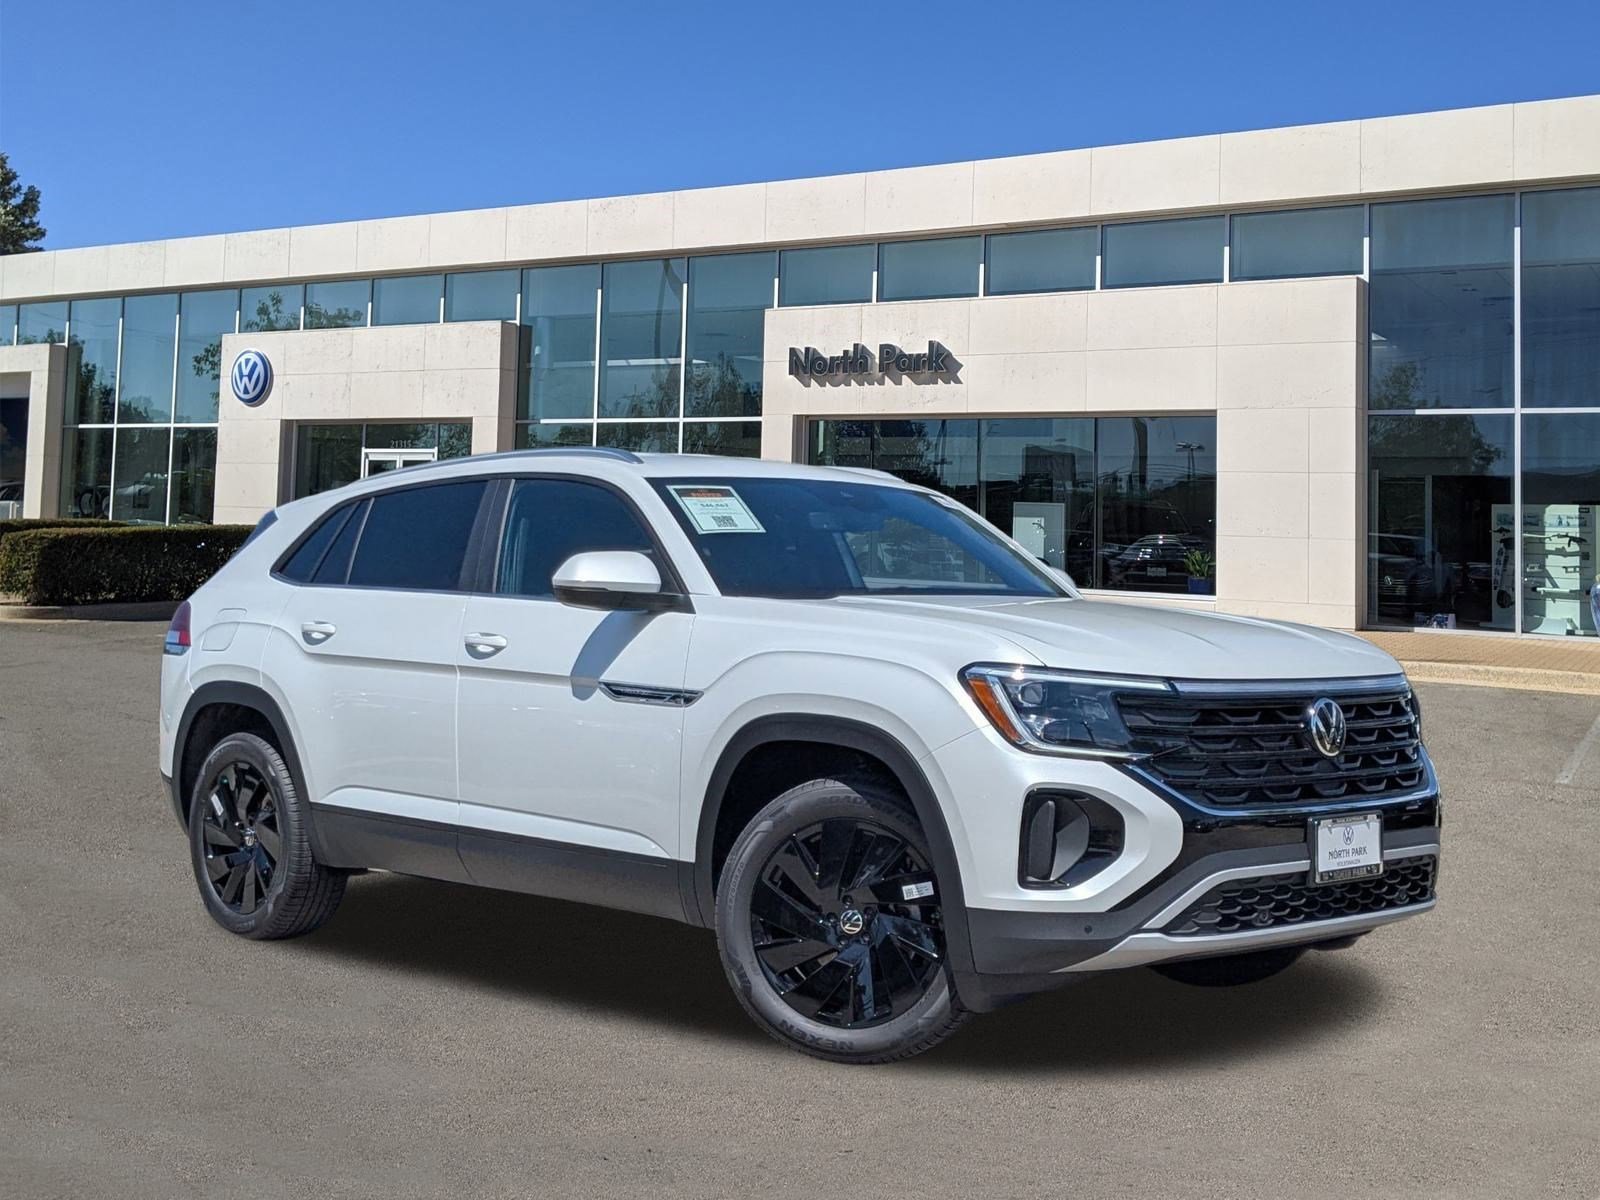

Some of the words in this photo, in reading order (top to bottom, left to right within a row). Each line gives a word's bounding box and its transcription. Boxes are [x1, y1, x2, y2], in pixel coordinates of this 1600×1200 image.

[788, 343, 872, 376] North
[879, 340, 948, 373] Park
[232, 350, 270, 403] VW
[390, 439, 412, 449] 21315
[1343, 826, 1354, 845] VW
[1328, 848, 1350, 860] NORTH
[1351, 846, 1368, 857] PARK
[779, 1019, 855, 1051] NEXEN
